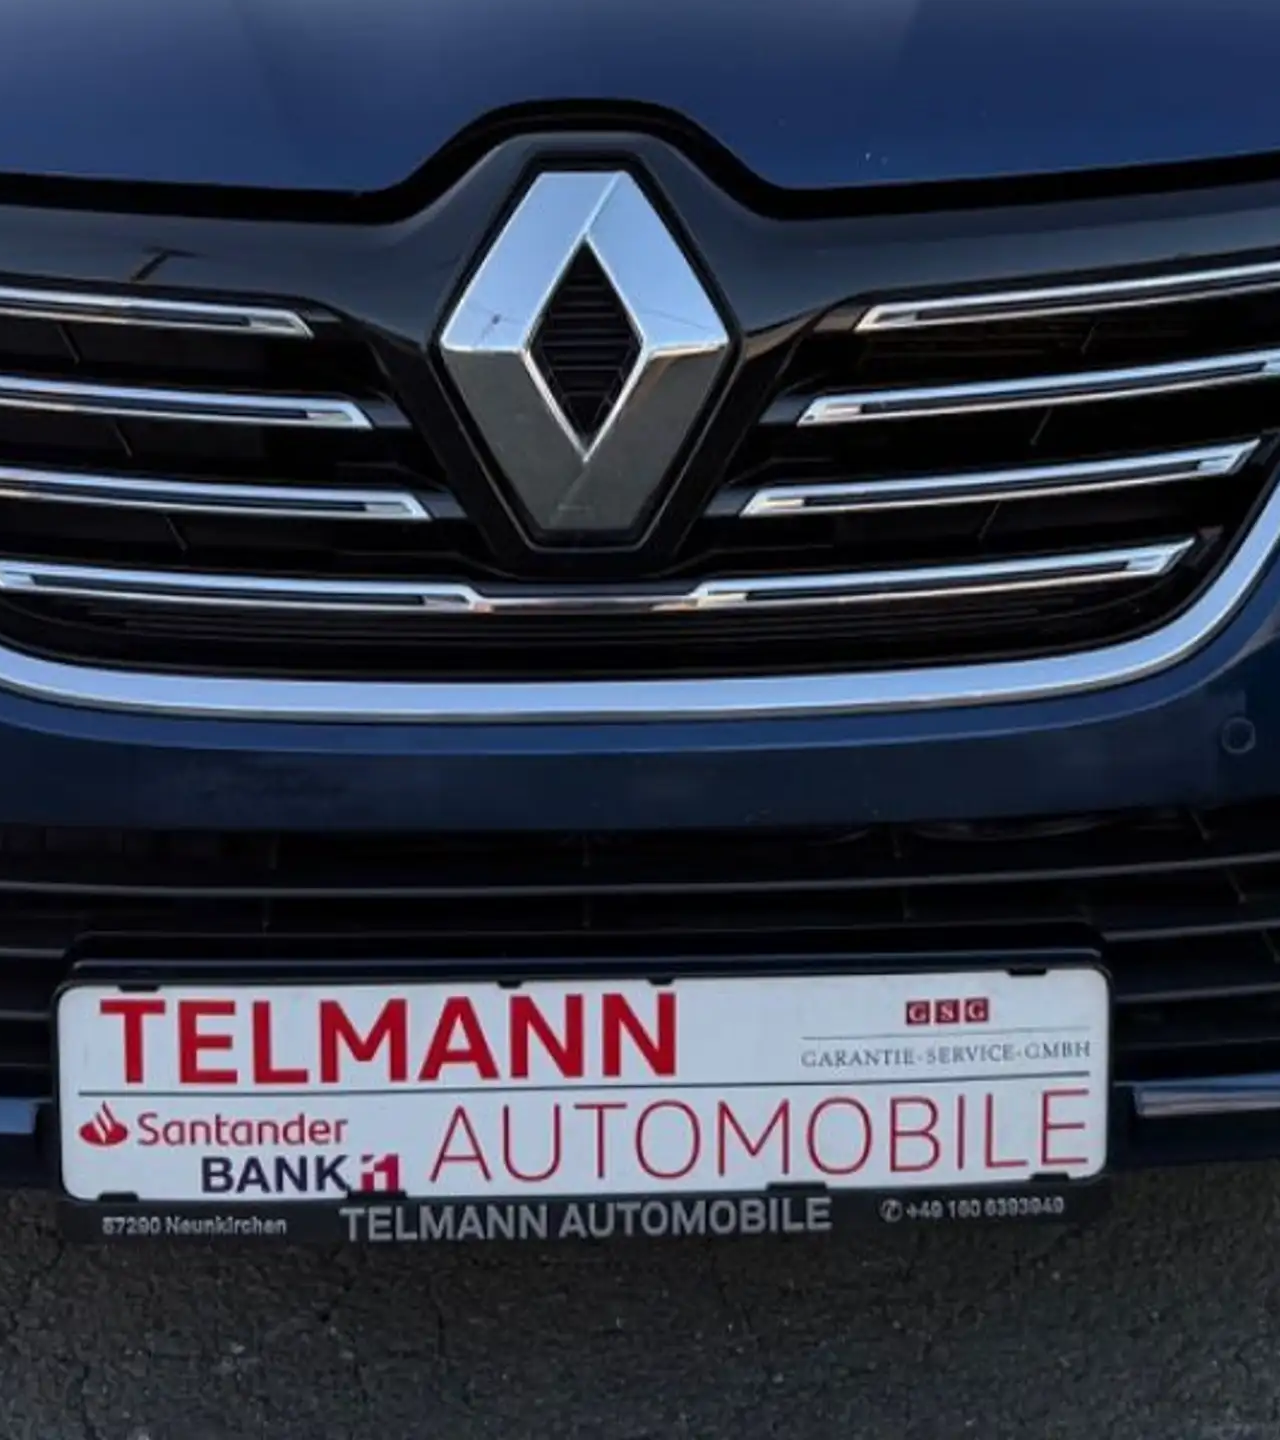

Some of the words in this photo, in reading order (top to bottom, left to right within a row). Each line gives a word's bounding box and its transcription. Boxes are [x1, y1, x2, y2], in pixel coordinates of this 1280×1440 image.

[906, 998, 990, 1026] GSG
[100, 993, 677, 1085] TELMANN
[136, 1112, 349, 1146] Santander
[430, 1090, 1090, 1184] AUTOMOBILE
[165, 1215, 287, 1236] Neunkirchen
[339, 1203, 548, 1242] TELMANN
[559, 1197, 833, 1238] AUTOMOBILE
